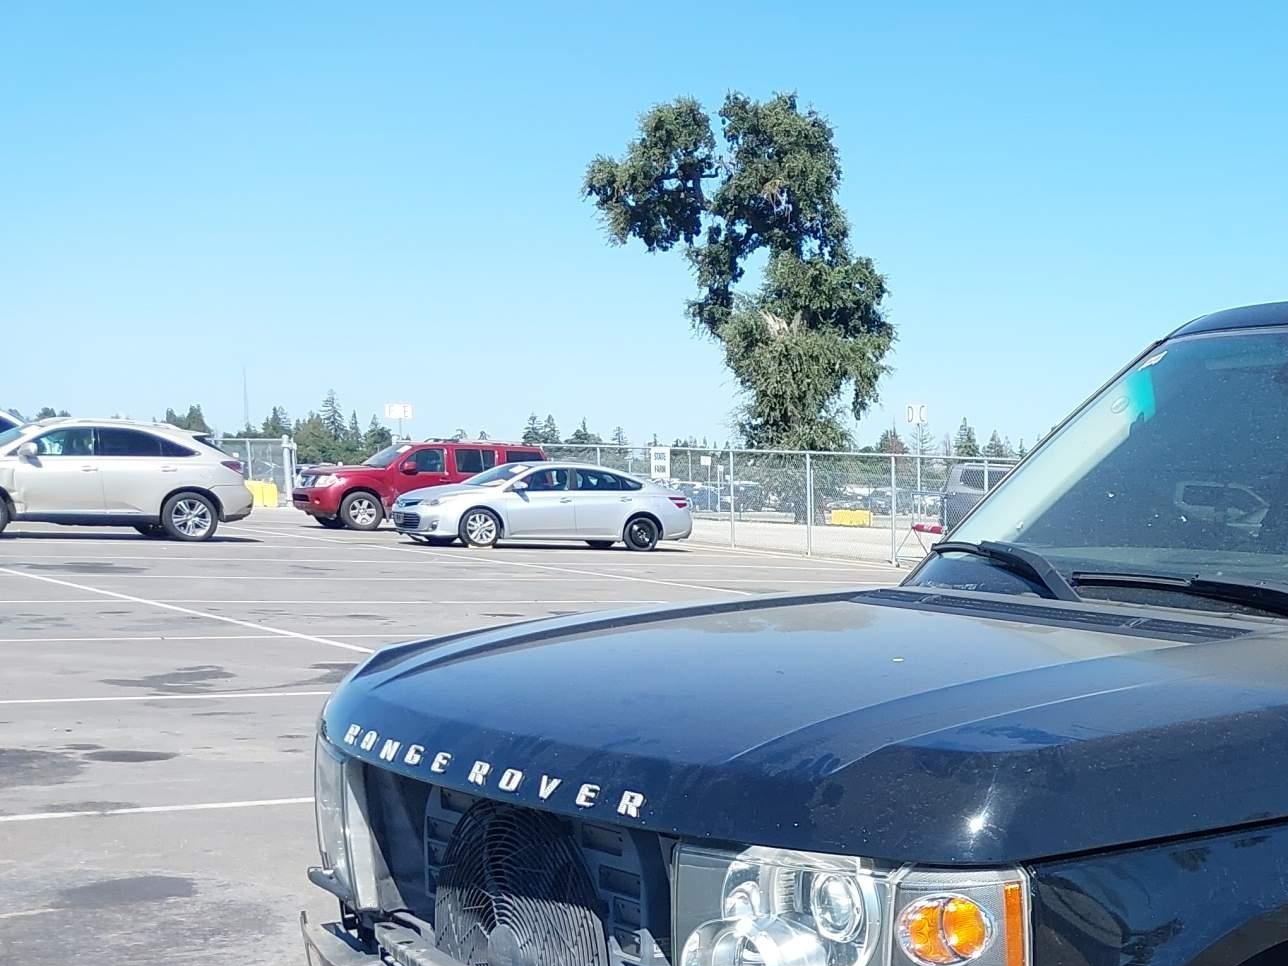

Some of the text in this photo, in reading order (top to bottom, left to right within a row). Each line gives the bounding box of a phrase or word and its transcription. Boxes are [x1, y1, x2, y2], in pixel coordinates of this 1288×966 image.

[907, 404, 926, 423] D C
[343, 723, 647, 818] RANGE ROVER
